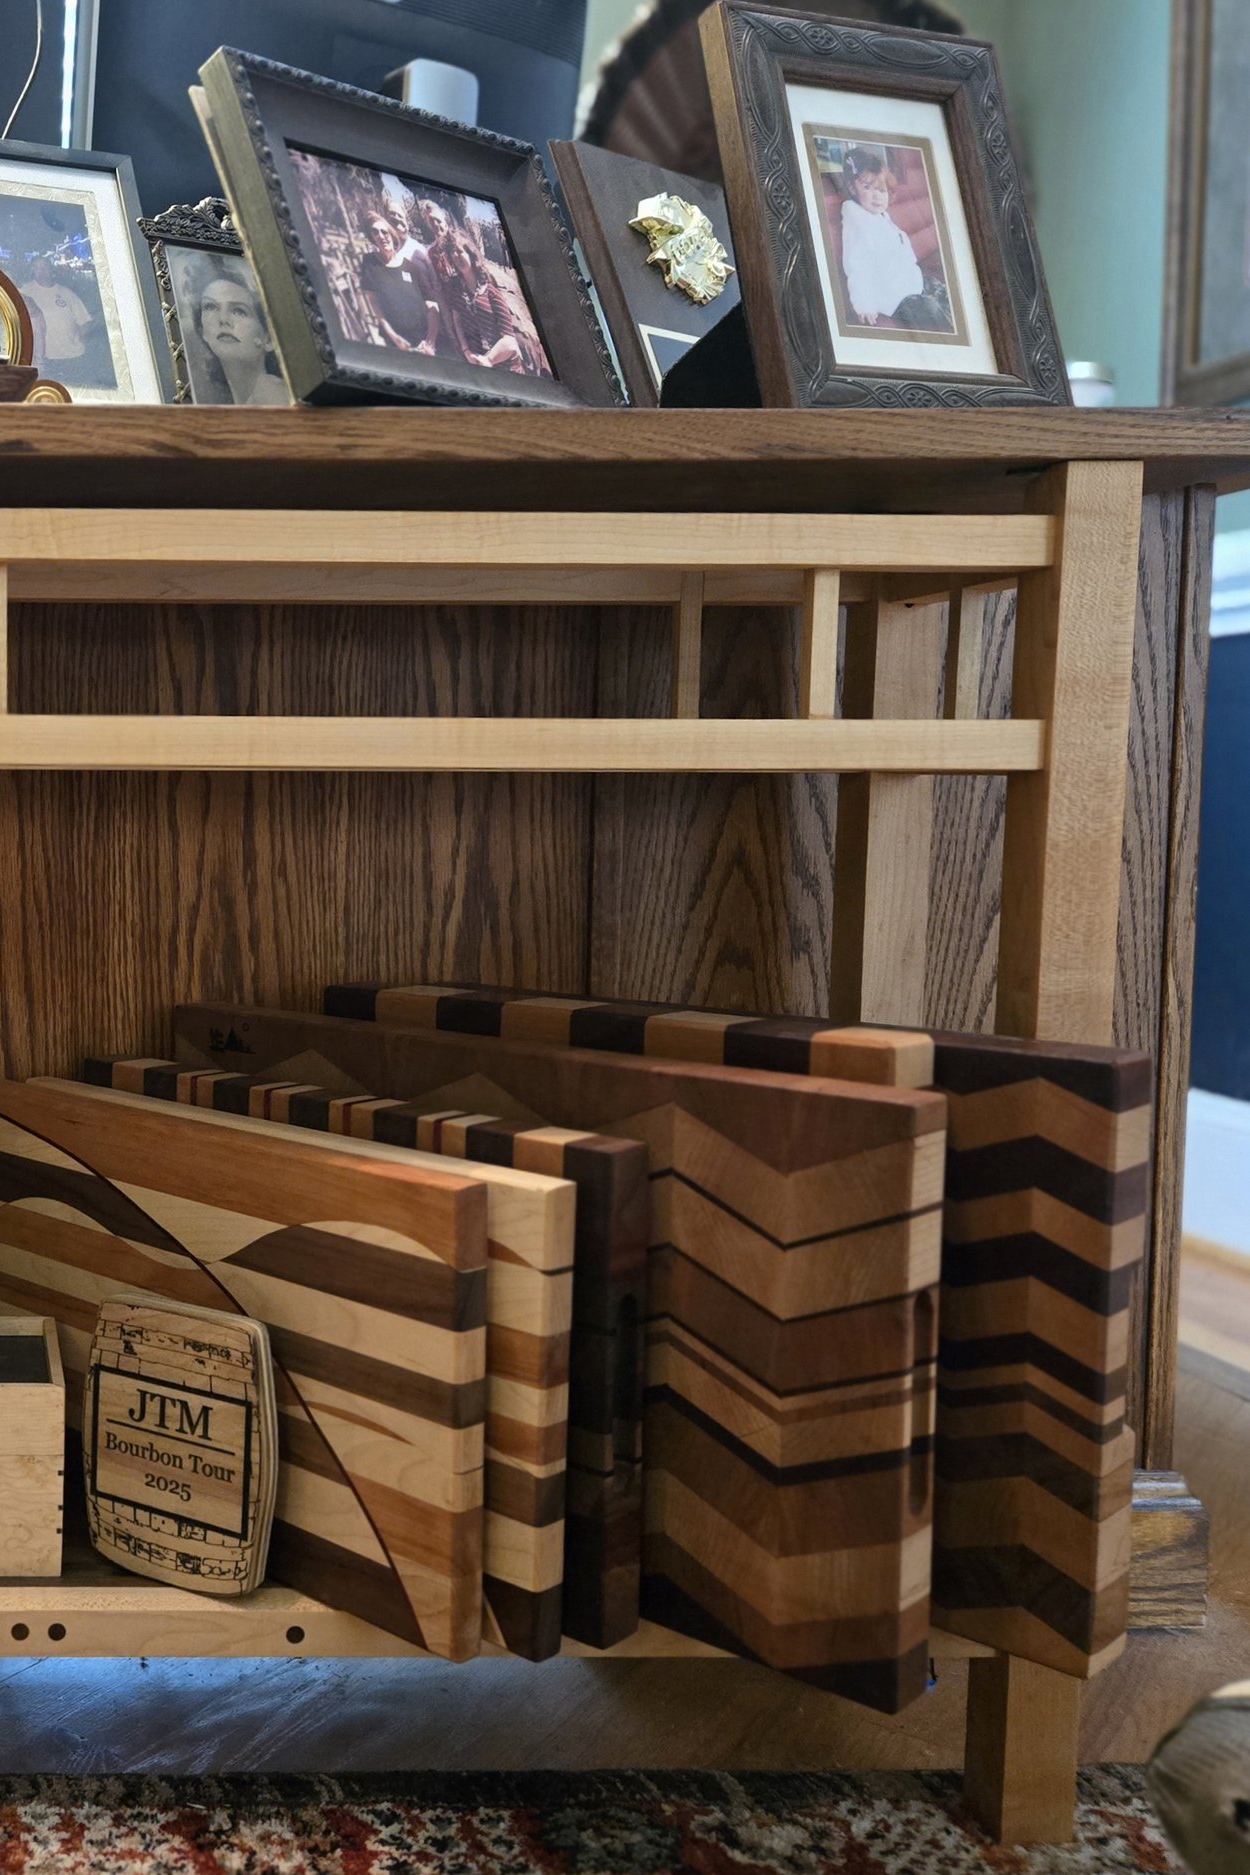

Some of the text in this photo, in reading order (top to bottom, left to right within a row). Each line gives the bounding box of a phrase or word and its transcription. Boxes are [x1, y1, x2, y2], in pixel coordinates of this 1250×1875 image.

[128, 1388, 213, 1442] JTM
[104, 1430, 236, 1484] Bourbon Tour
[144, 1472, 192, 1503] 2025
